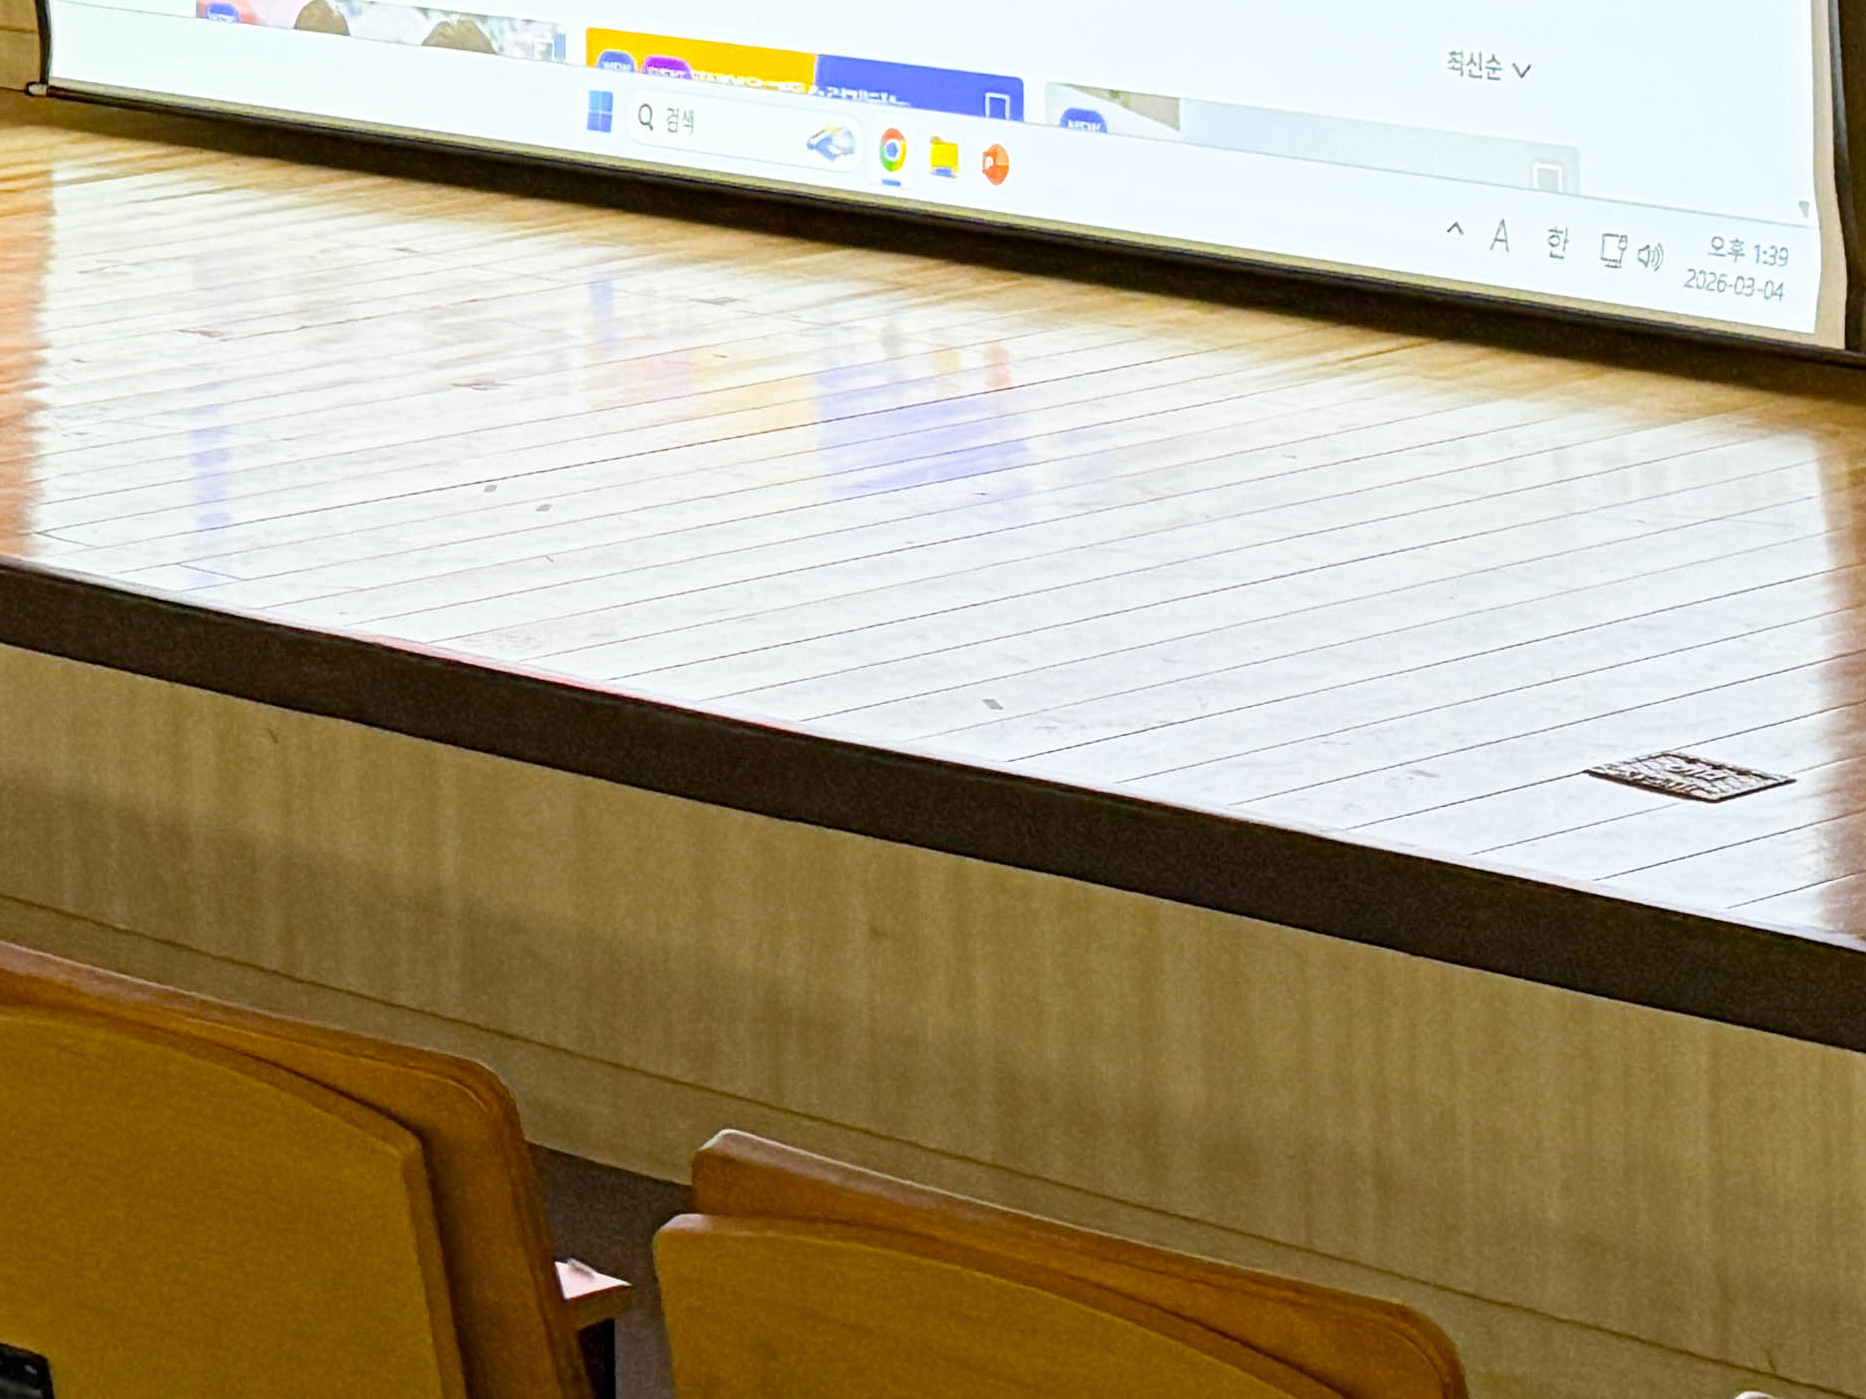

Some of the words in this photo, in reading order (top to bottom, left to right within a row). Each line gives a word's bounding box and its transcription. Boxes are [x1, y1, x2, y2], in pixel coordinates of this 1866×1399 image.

[1446, 50, 1503, 82] 최신순
[665, 106, 695, 135] 검색
[1489, 218, 1510, 253] A
[1547, 227, 1569, 260] 한
[1707, 235, 1746, 264] 오후
[1752, 244, 1789, 267] 1:39
[1684, 268, 1785, 302] 2026-03-04
